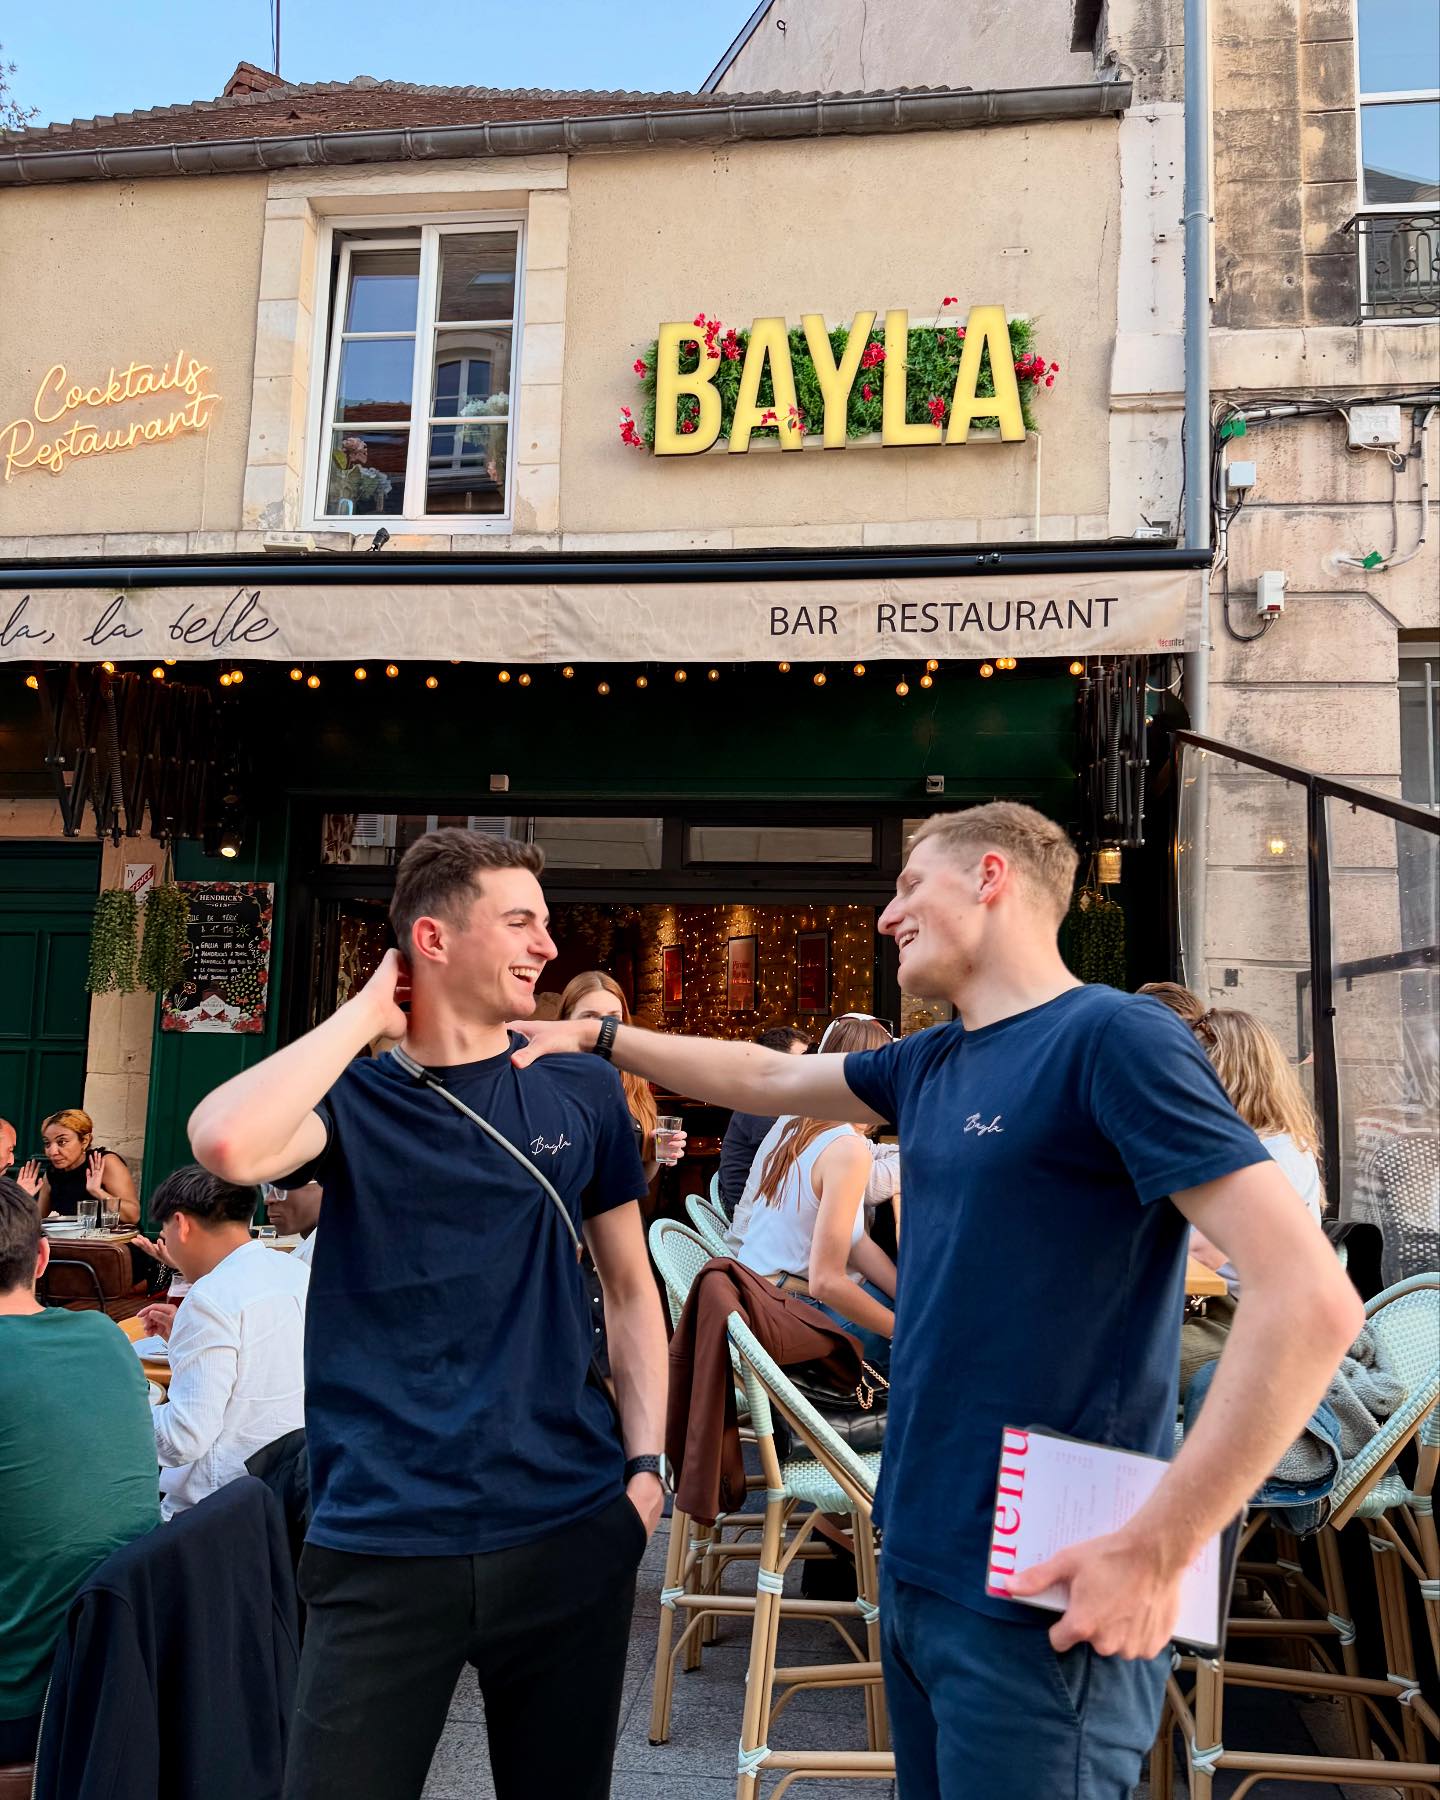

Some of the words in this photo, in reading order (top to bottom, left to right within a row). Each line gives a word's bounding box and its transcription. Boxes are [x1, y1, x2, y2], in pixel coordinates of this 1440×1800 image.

[33, 350, 210, 424] Cocktails
[654, 304, 1026, 457] BAYLA
[0, 394, 221, 481] Restaurant
[83, 595, 144, 646] la
[169, 587, 280, 648] belle
[770, 605, 838, 636] BAR
[877, 597, 1119, 633] RESTAURANT
[199, 894, 243, 902] HENDRICK'S
[529, 1133, 572, 1155] Bayla
